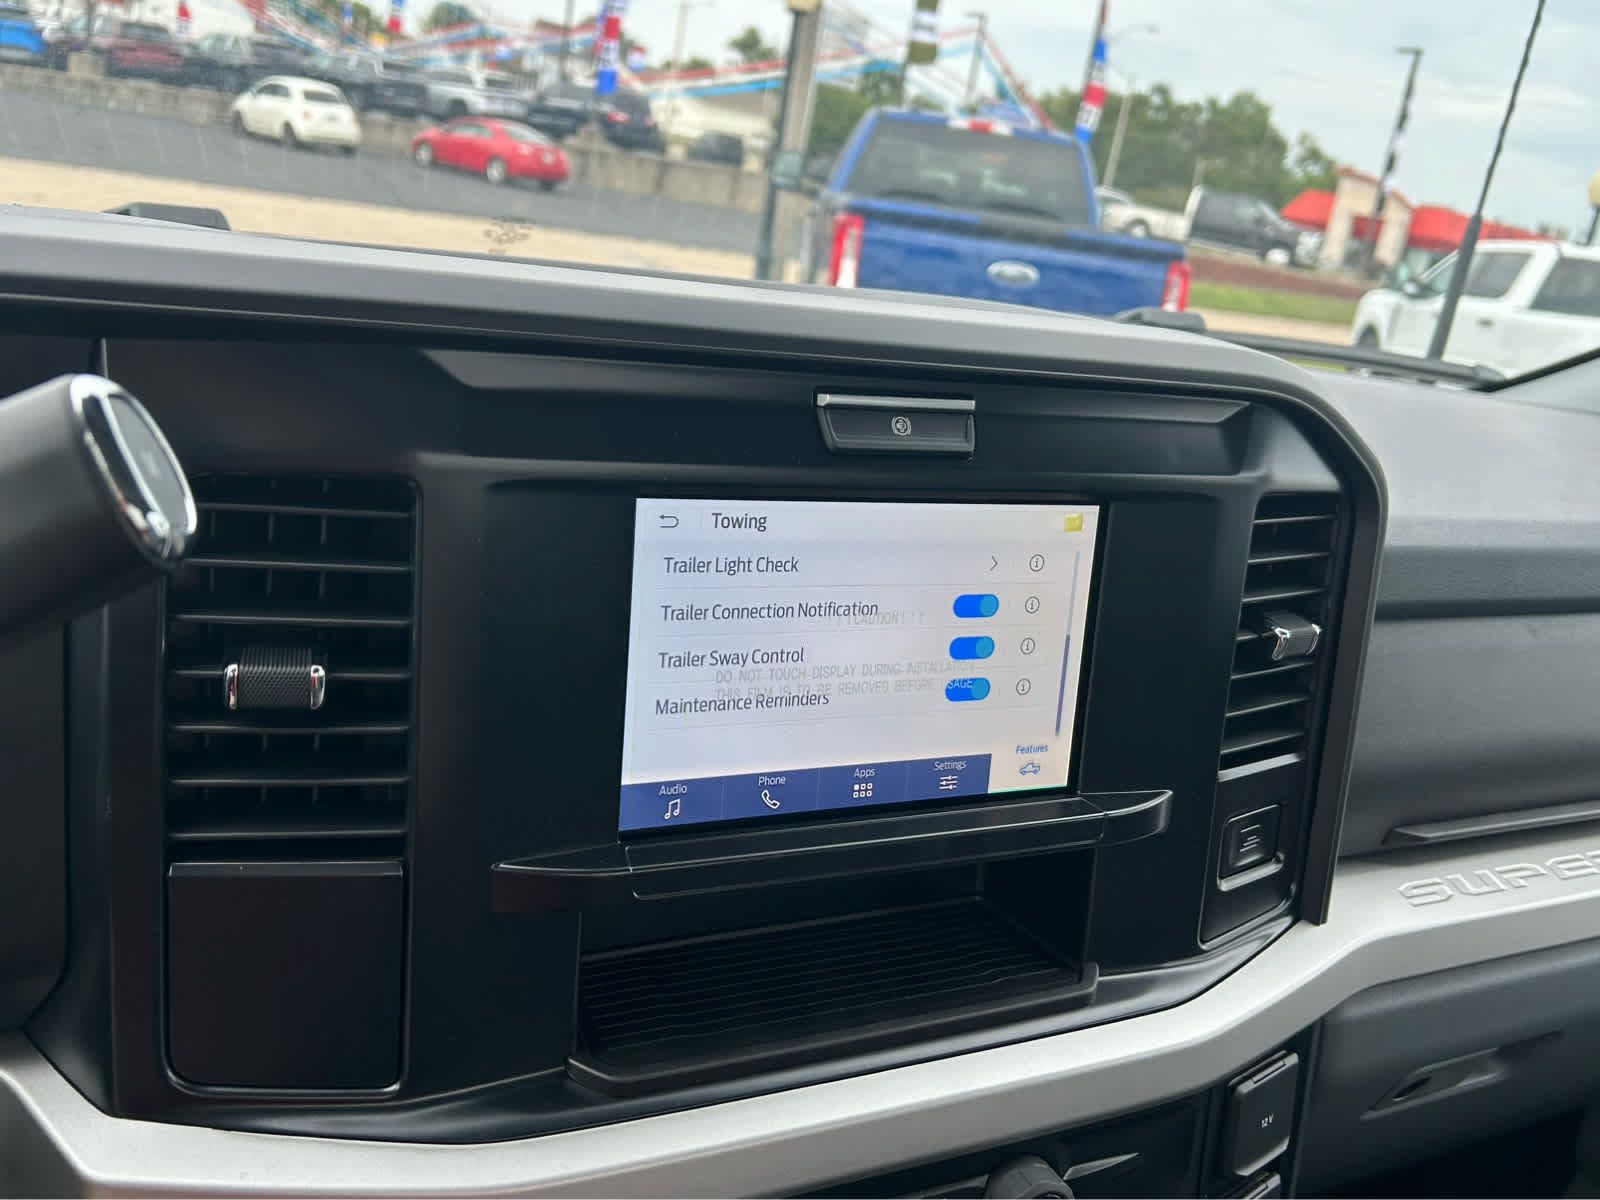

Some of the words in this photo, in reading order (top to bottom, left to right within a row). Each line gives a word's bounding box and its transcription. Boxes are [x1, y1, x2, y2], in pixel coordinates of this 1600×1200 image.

[711, 512, 768, 532] Towing
[663, 556, 712, 574] Trailer
[715, 556, 753, 576] Light
[756, 556, 800, 573] Check
[660, 604, 709, 622] Trailer
[712, 603, 794, 620] Connection
[798, 601, 879, 618] Notification
[658, 651, 707, 669] Trailer
[709, 650, 749, 667] Sway
[752, 647, 804, 665] Control
[714, 670, 733, 684] DO
[738, 669, 763, 683] NOT
[769, 667, 808, 682] TOUCH
[812, 664, 857, 680] DISPLAY
[862, 663, 902, 678] DURING
[838, 681, 889, 698] REMOVED
[655, 696, 752, 716] Maintenance
[755, 690, 830, 710] Reminders
[1015, 743, 1049, 755] Features
[853, 767, 876, 778] Apps
[934, 759, 968, 772] Settings
[758, 774, 787, 786] Phone
[659, 783, 688, 796] Audio
